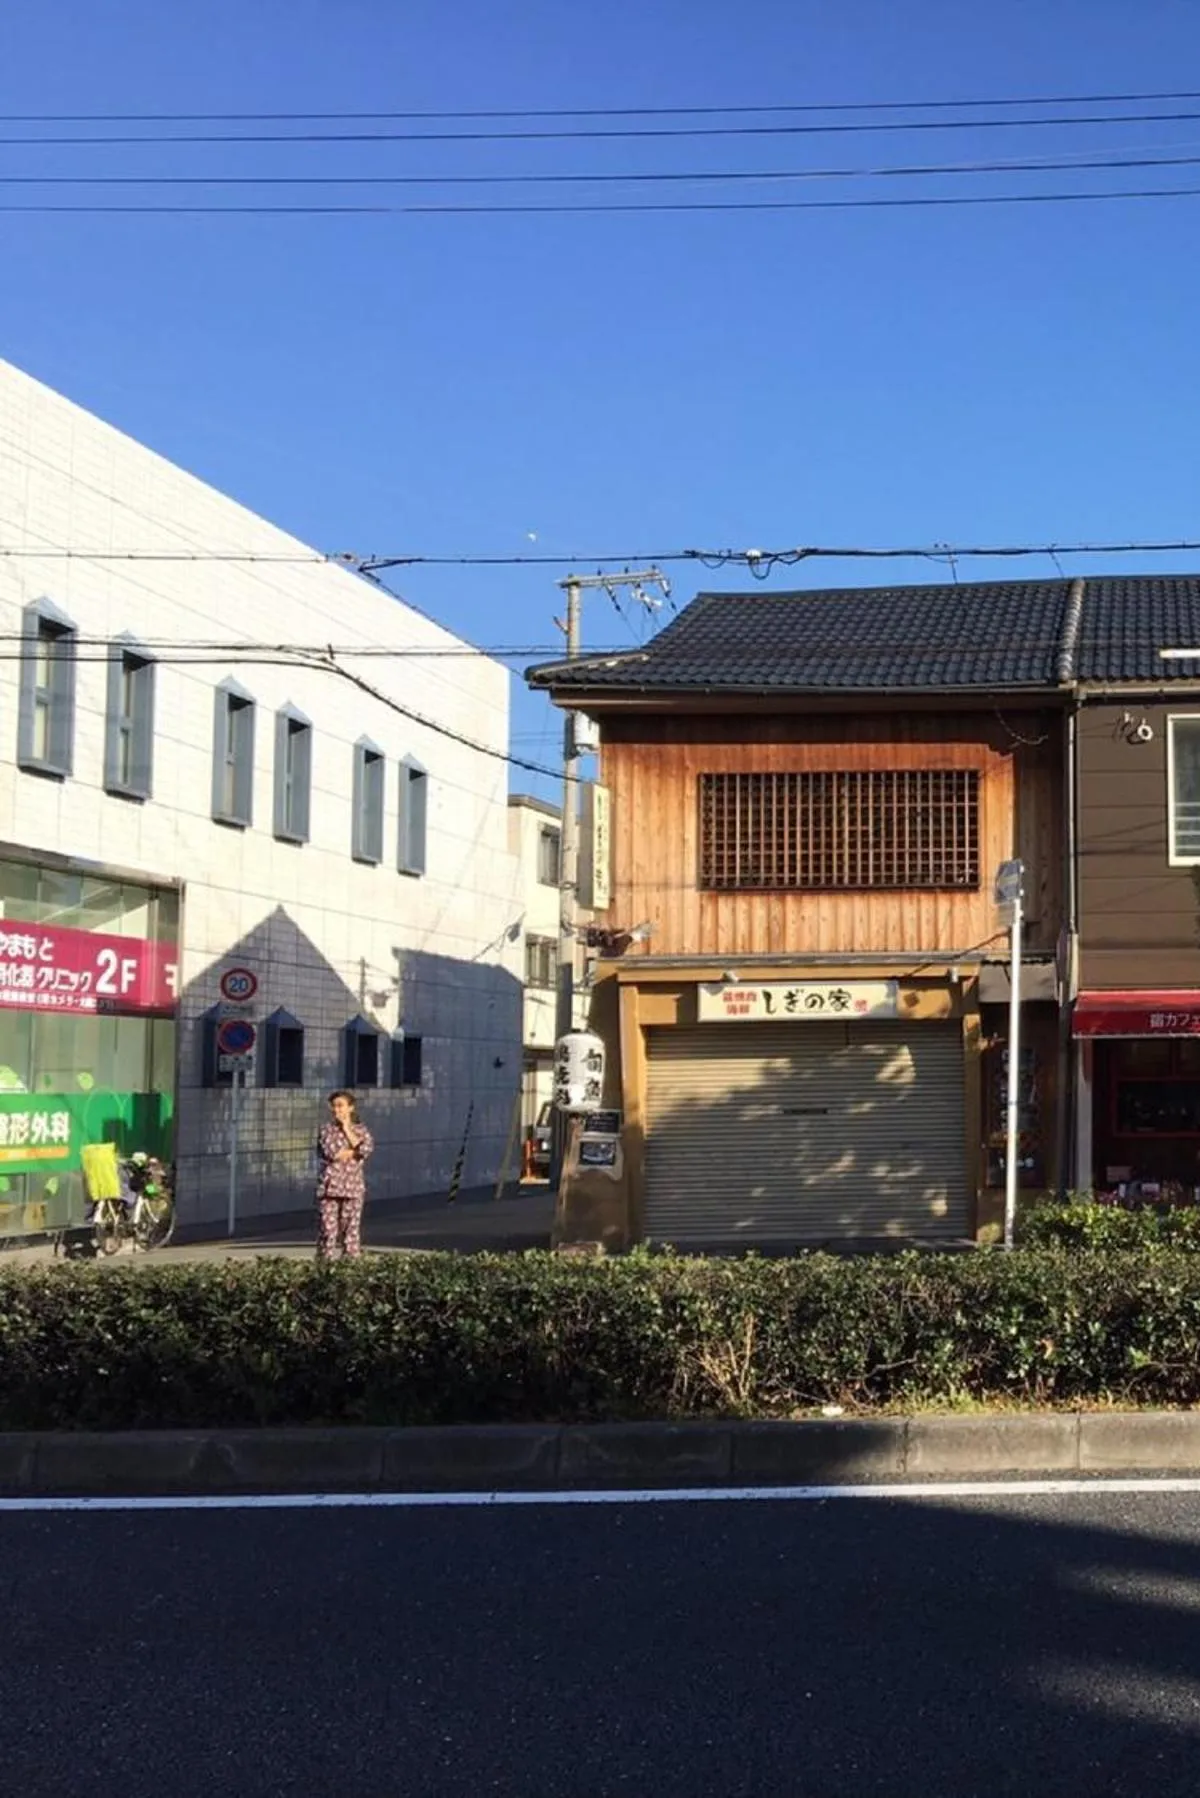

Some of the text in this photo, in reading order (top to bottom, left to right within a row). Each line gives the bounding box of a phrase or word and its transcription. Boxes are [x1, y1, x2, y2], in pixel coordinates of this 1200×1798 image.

[96, 948, 137, 994] 2F
[229, 977, 249, 992] 20
[762, 987, 852, 1014] しぎの家
